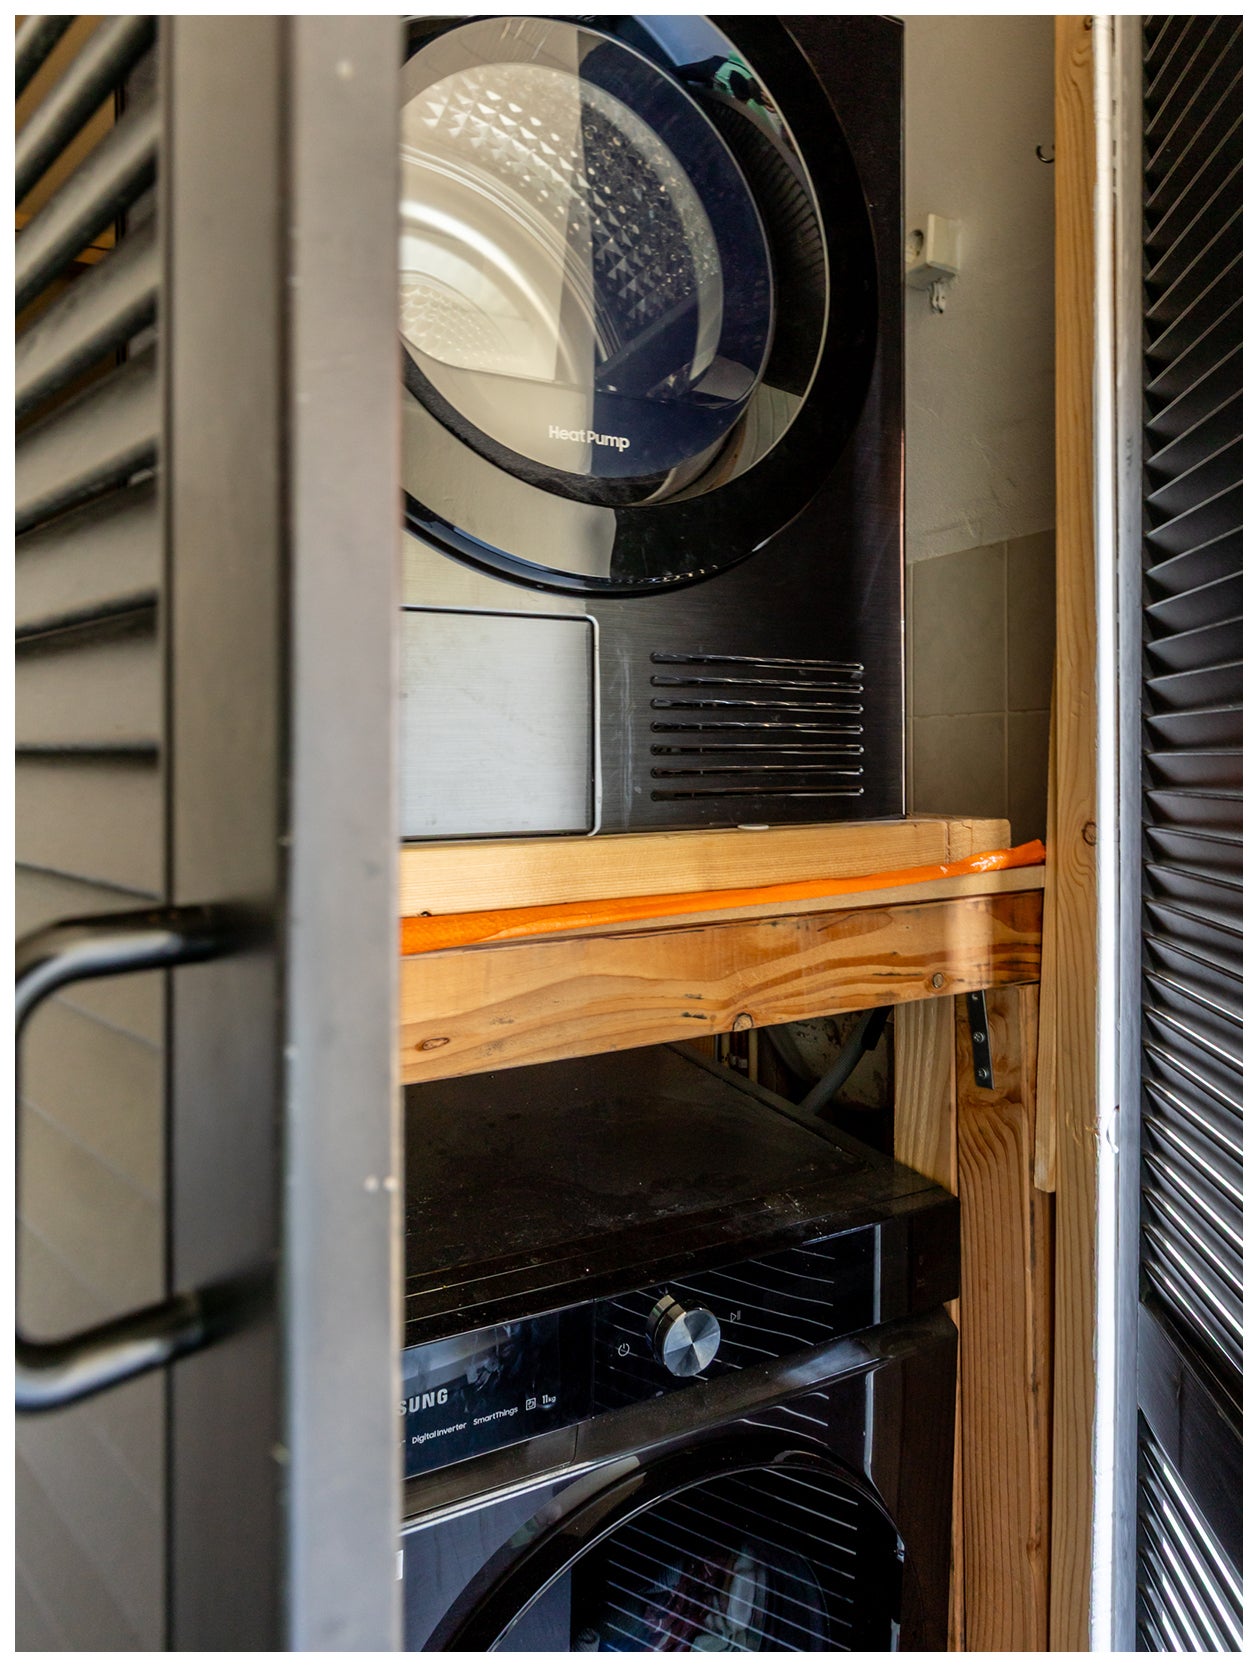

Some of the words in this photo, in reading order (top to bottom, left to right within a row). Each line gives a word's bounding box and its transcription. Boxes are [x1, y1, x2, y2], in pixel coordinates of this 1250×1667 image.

[548, 425, 586, 443] Heat
[587, 430, 630, 452] Pump
[473, 1407, 518, 1426] SmartThings
